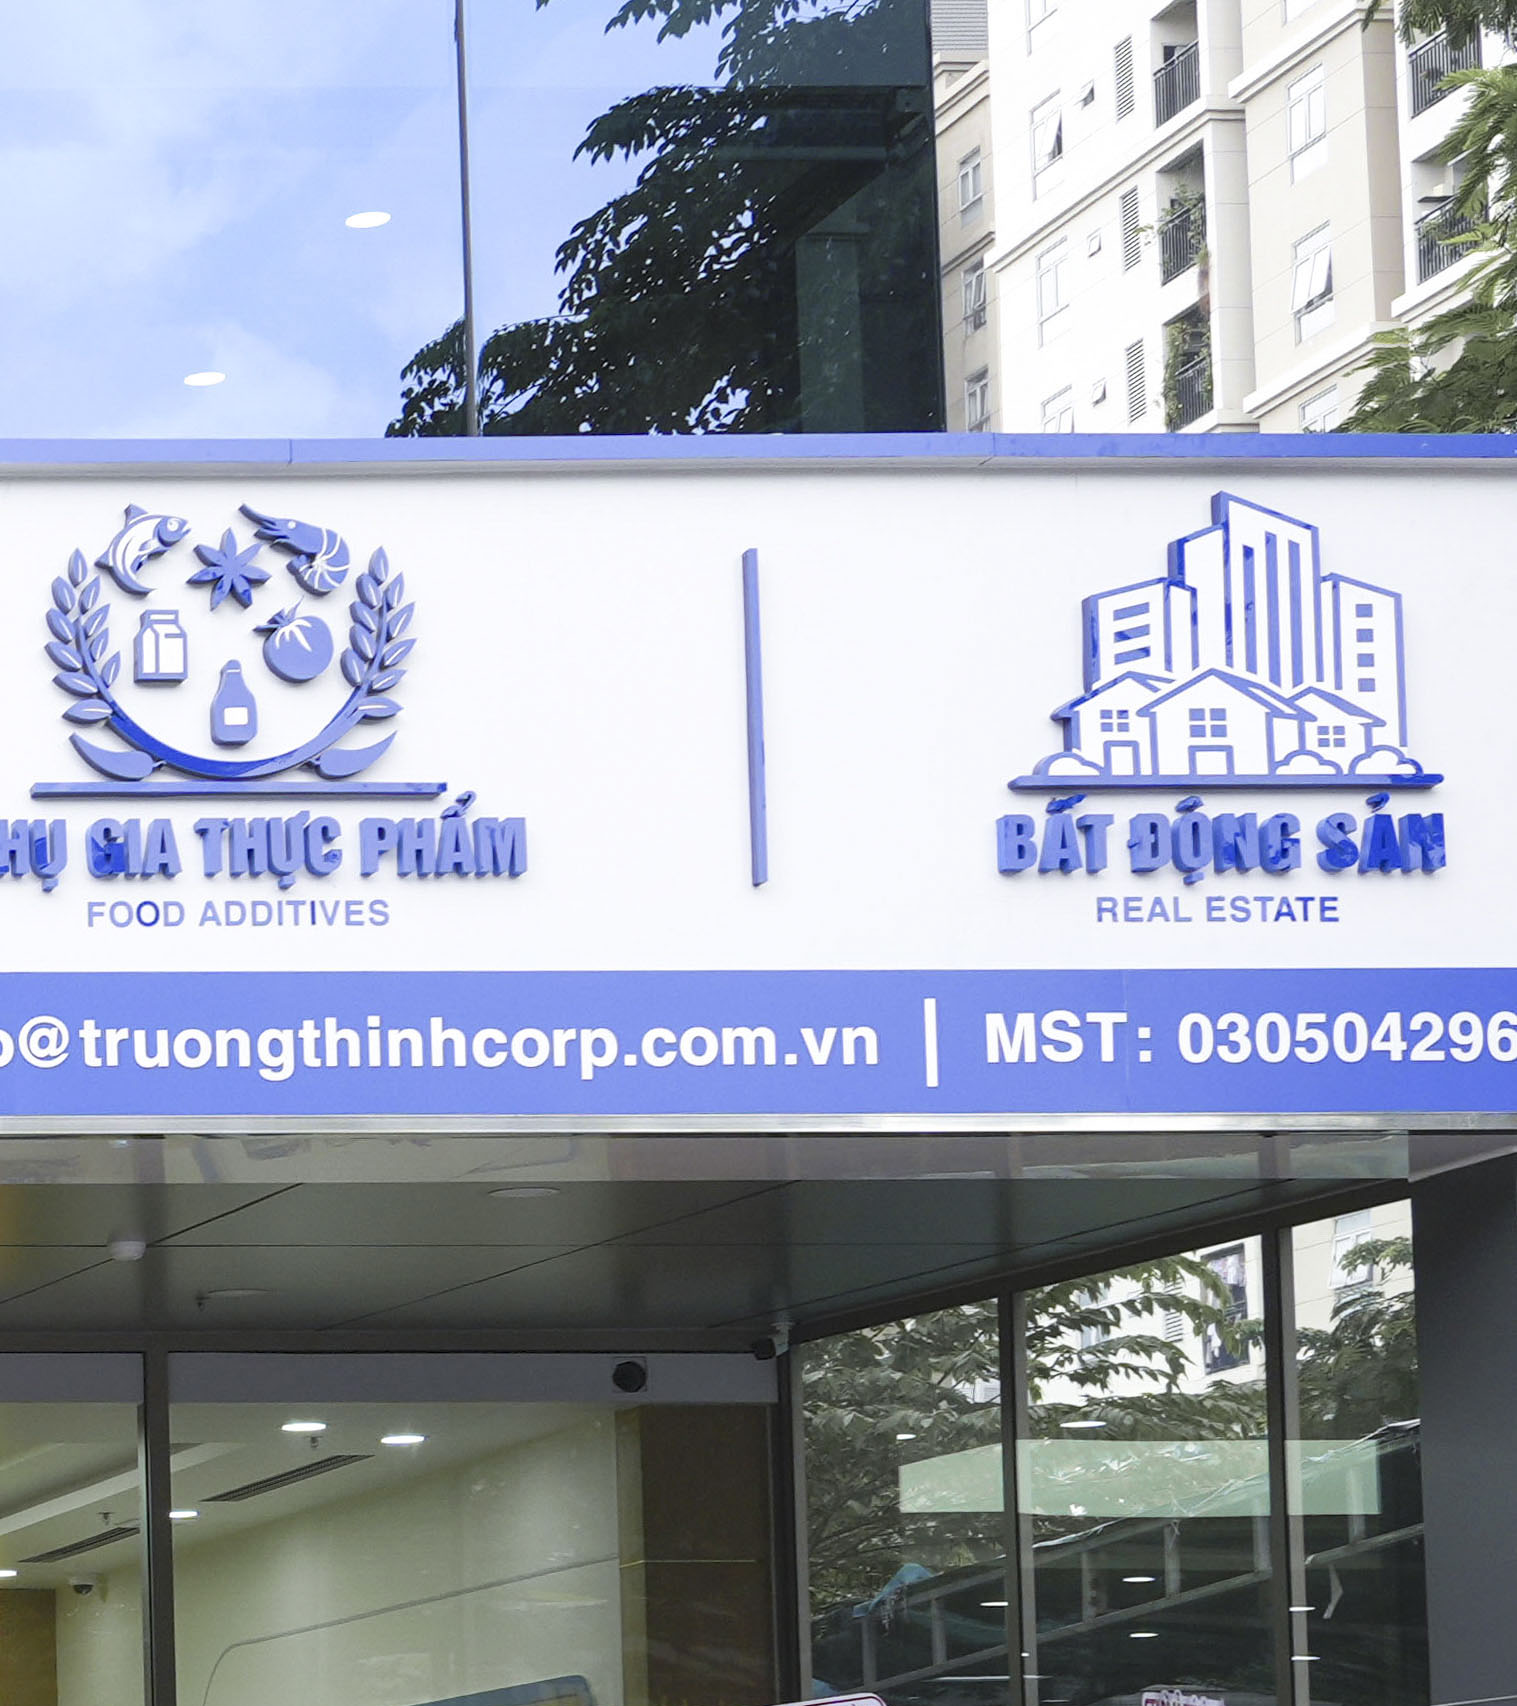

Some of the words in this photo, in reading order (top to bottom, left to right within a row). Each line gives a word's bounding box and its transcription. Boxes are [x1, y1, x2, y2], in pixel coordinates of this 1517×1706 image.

[86, 819, 181, 880] GIA
[193, 811, 343, 891] THỰC
[360, 791, 527, 880] PHẨM
[996, 793, 1114, 877] BẤT
[1126, 795, 1303, 886] ĐỘNG
[1316, 792, 1447, 876] SẢN
[88, 901, 184, 927] FOOD
[200, 900, 388, 926] ADDITIVES
[1097, 897, 1192, 922] REAL
[1206, 896, 1339, 922] ESTATE
[1179, 1012, 1517, 1062] 030504296
